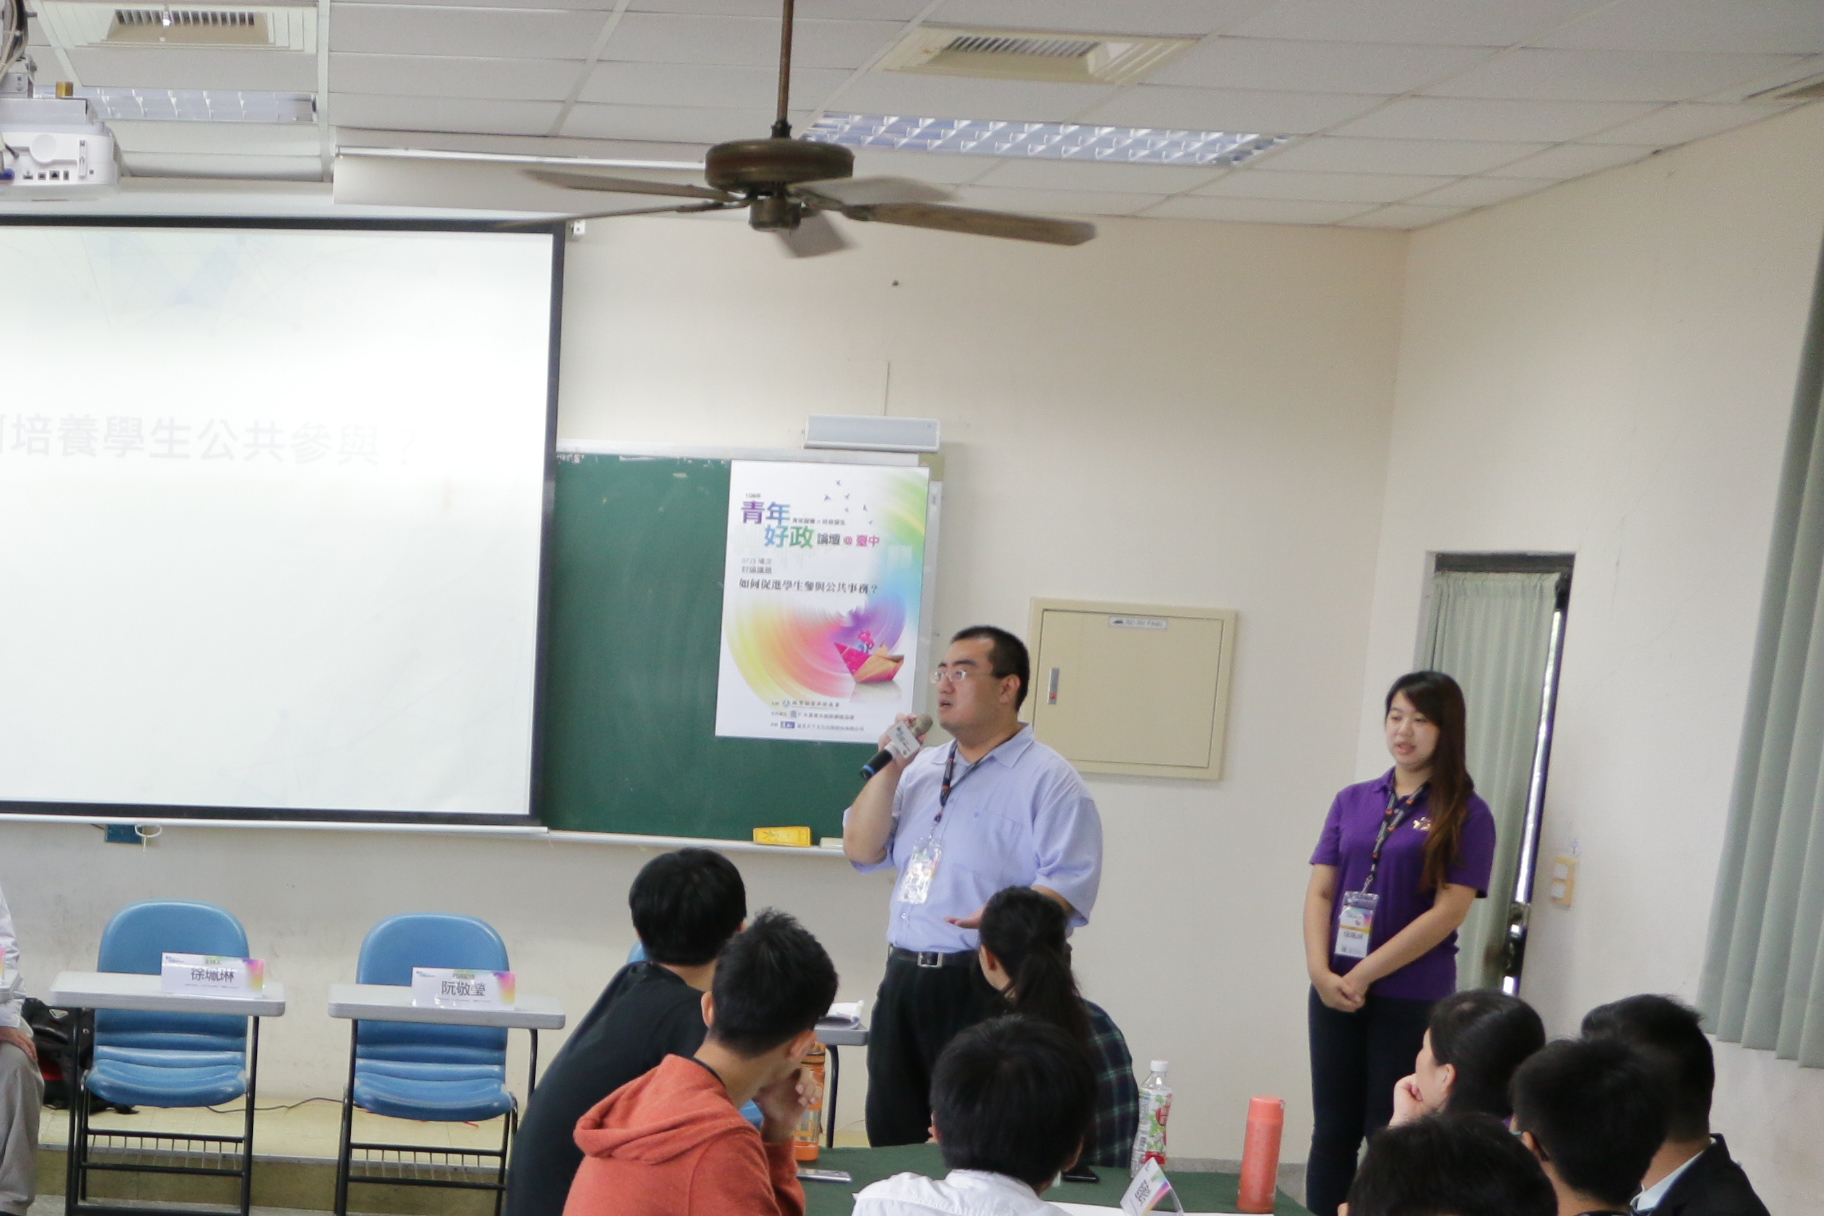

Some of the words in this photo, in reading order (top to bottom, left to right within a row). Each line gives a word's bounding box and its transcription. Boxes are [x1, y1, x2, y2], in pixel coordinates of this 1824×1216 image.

[740, 500, 790, 525] 青年
[764, 524, 815, 549] 好政
[817, 532, 841, 546] 論壇
[856, 534, 881, 548] 臺中
